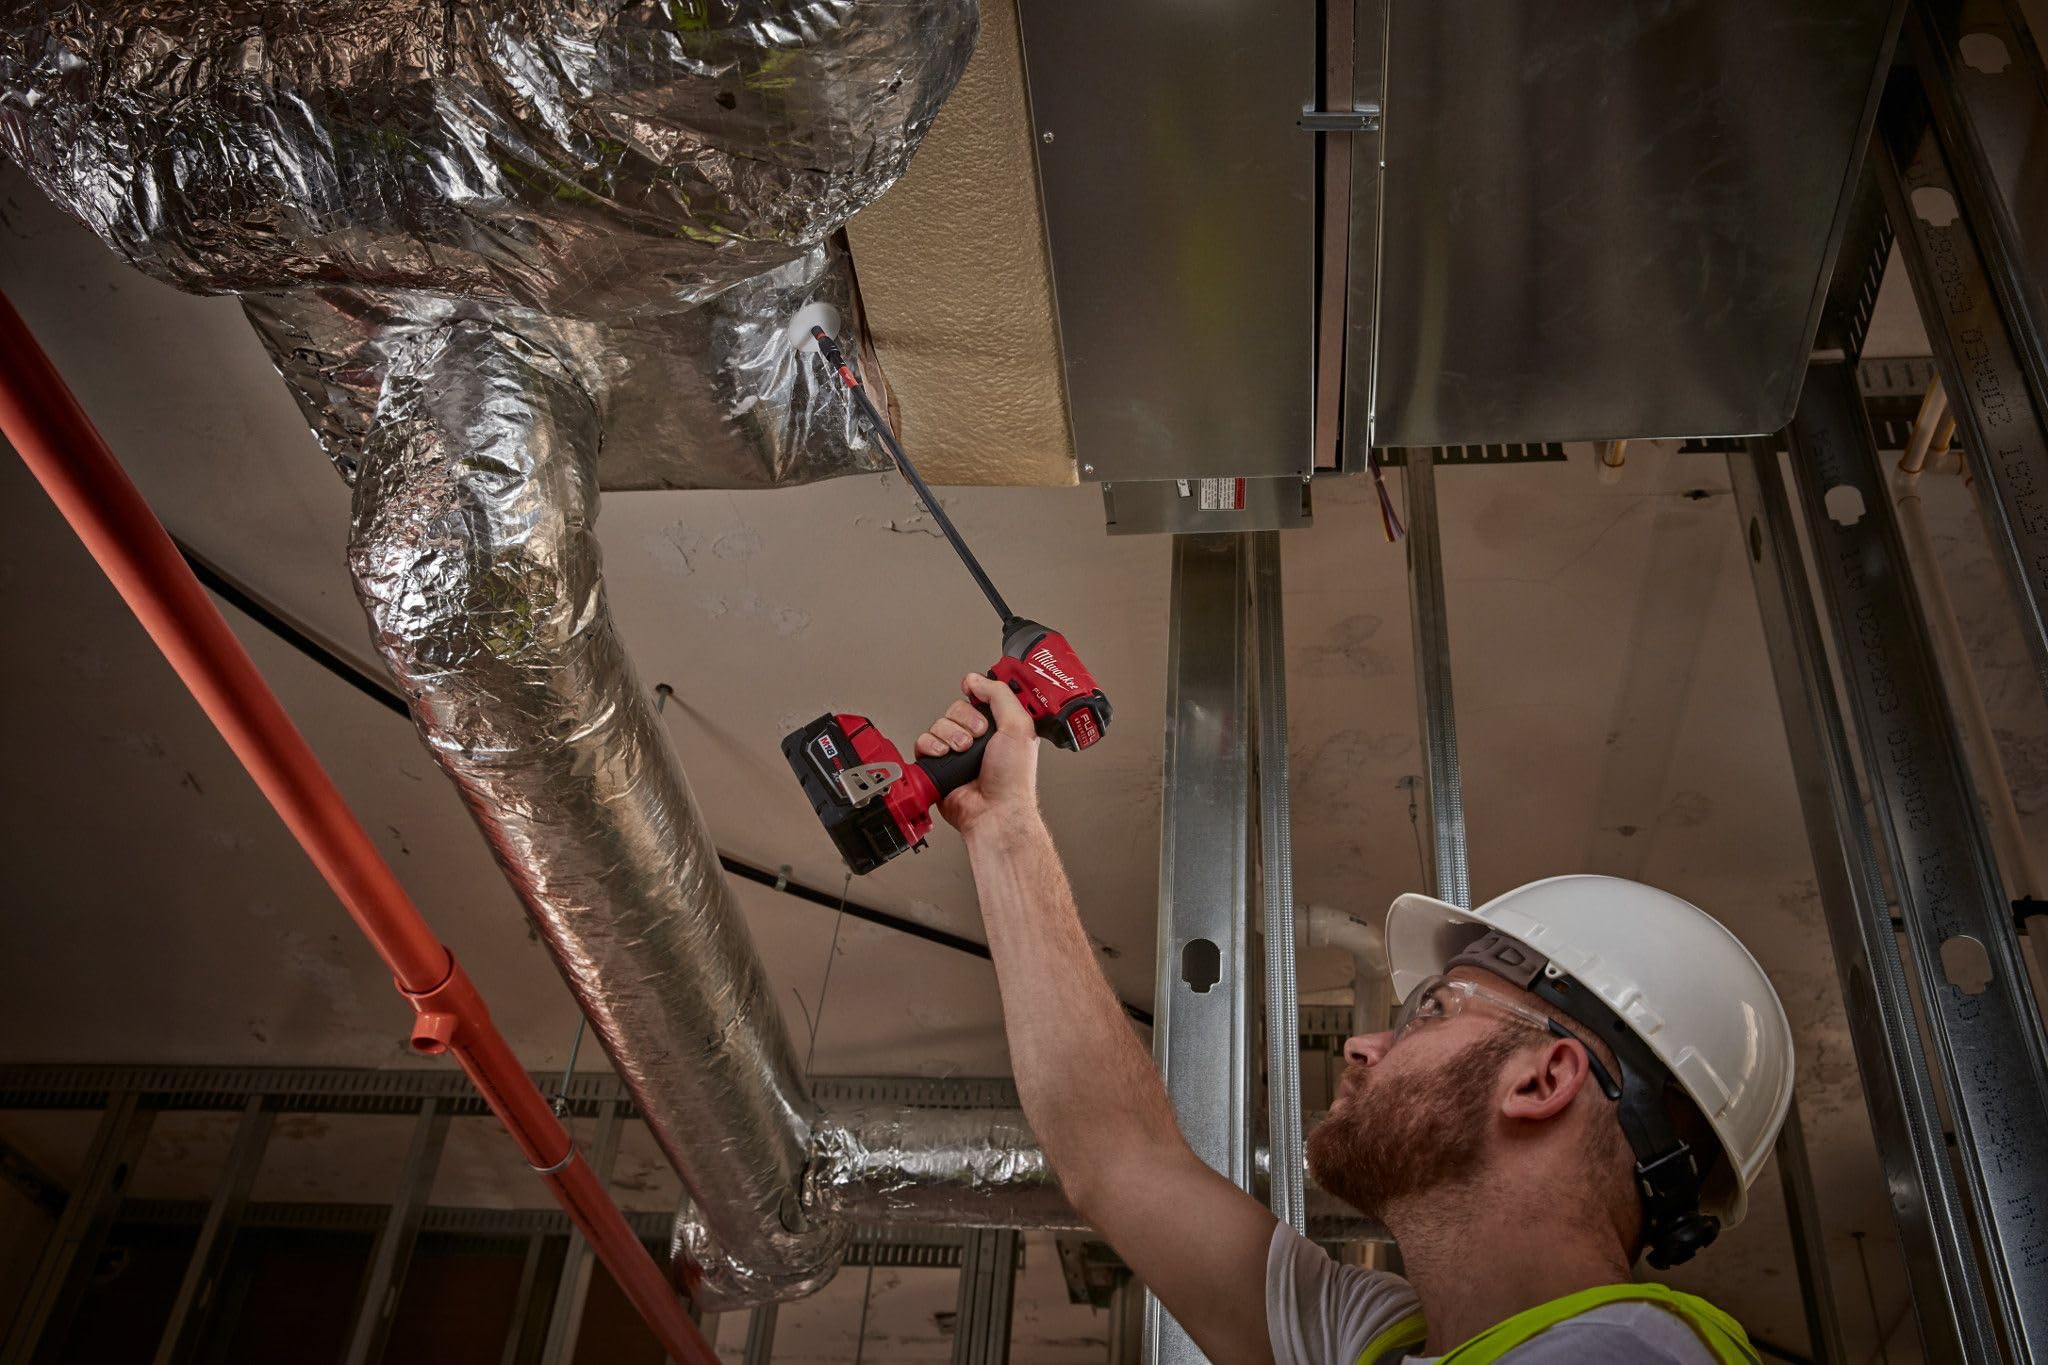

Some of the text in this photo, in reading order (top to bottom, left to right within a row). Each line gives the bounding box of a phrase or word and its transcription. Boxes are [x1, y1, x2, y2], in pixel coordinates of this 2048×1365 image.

[1032, 648, 1078, 690] Milwaukee
[1031, 687, 1051, 708] FUEL
[1078, 712, 1099, 742] FUEL
[819, 735, 836, 757] M18
